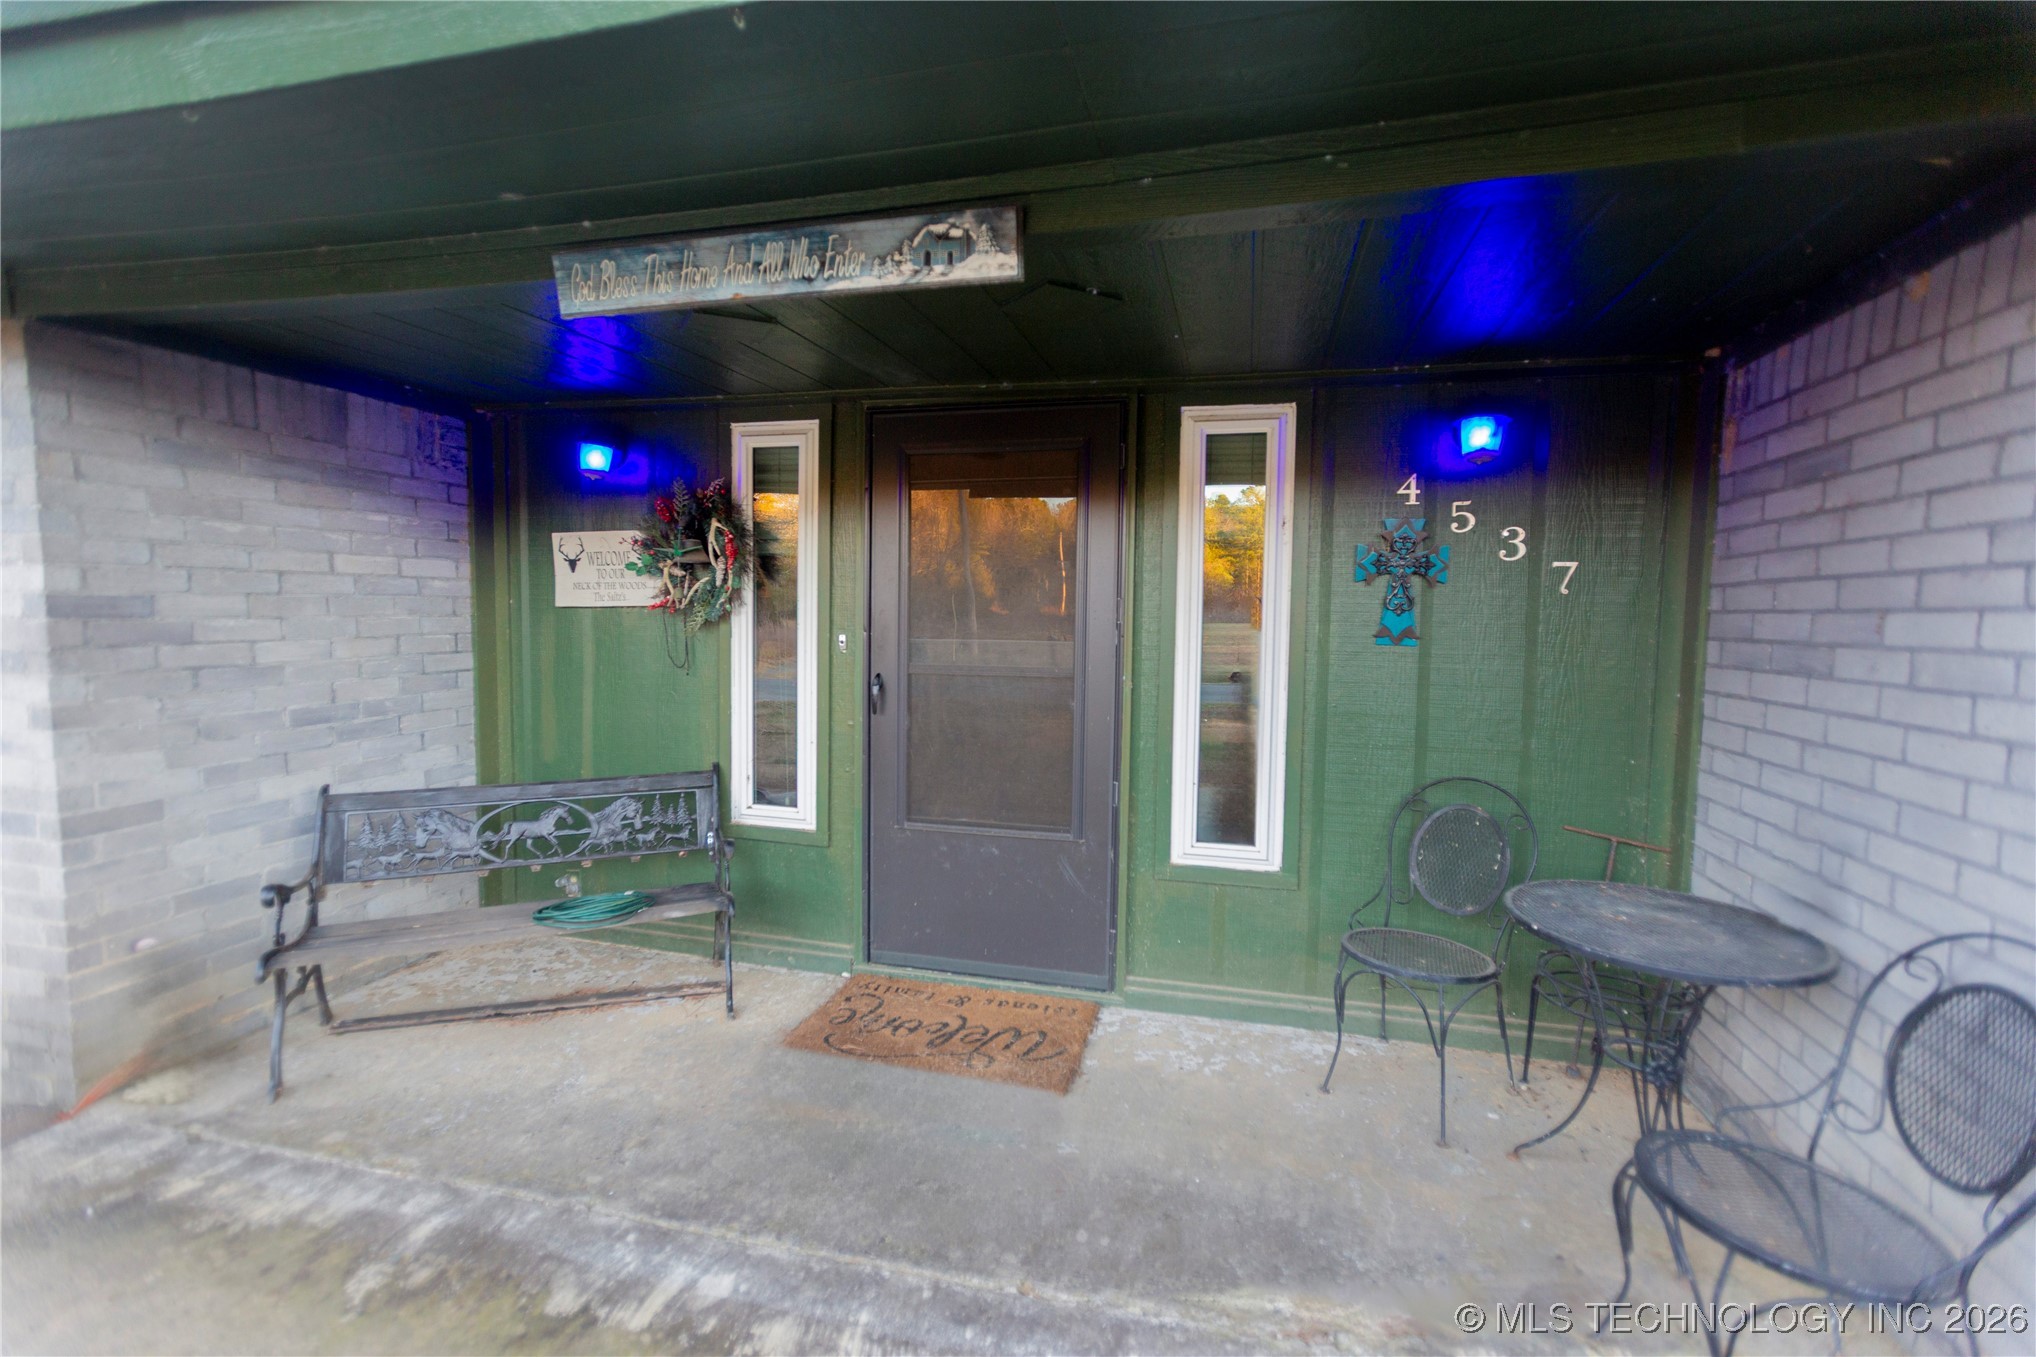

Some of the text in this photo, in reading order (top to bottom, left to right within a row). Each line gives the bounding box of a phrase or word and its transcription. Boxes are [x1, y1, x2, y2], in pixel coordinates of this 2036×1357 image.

[571, 234, 866, 308] God Bless This Home And All Who Enter
[586, 550, 631, 566] WELCOME
[596, 568, 625, 579] TO OUR
[572, 582, 591, 591] NECK
[592, 582, 602, 591] OF
[603, 581, 617, 590] THE
[594, 591, 606, 602] The
[947, 994, 972, 1008] &
[823, 993, 1067, 1070] Welcome
